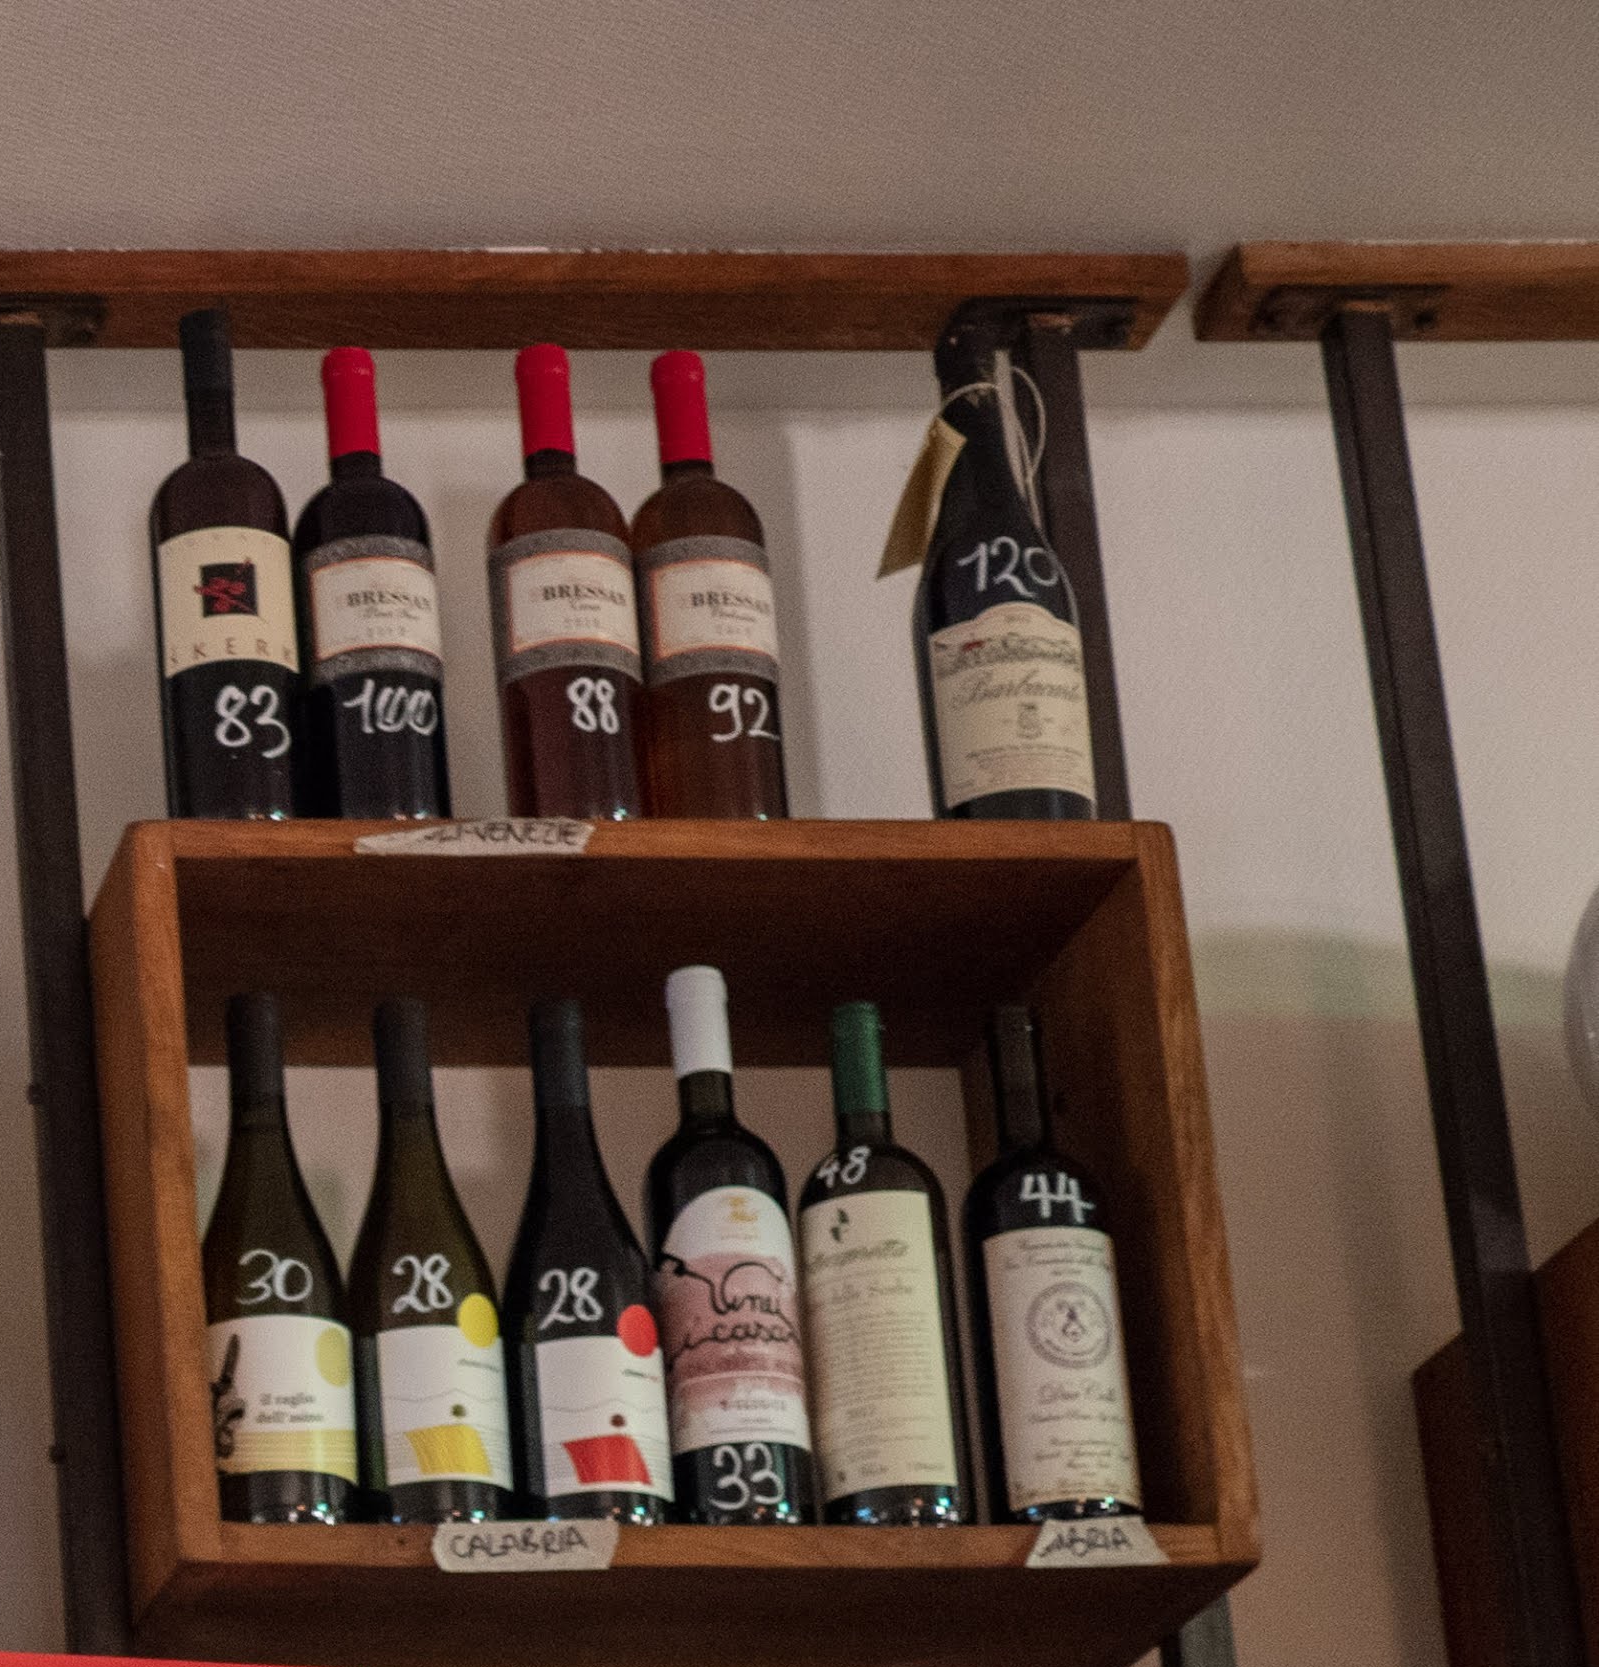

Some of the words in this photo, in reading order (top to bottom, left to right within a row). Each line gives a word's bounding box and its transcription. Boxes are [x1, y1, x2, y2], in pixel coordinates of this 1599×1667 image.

[957, 536, 1059, 598] 120
[215, 685, 292, 759] 83
[343, 679, 438, 735] 100
[567, 676, 620, 734] 88
[708, 683, 780, 743] 92
[817, 1146, 871, 1187] 48
[1020, 1172, 1095, 1223] 44
[238, 1249, 313, 1304] 30
[392, 1253, 454, 1313] 28
[538, 1267, 604, 1330] 28
[711, 1442, 784, 1511] 33
[450, 1524, 589, 1559] CALABRIA
